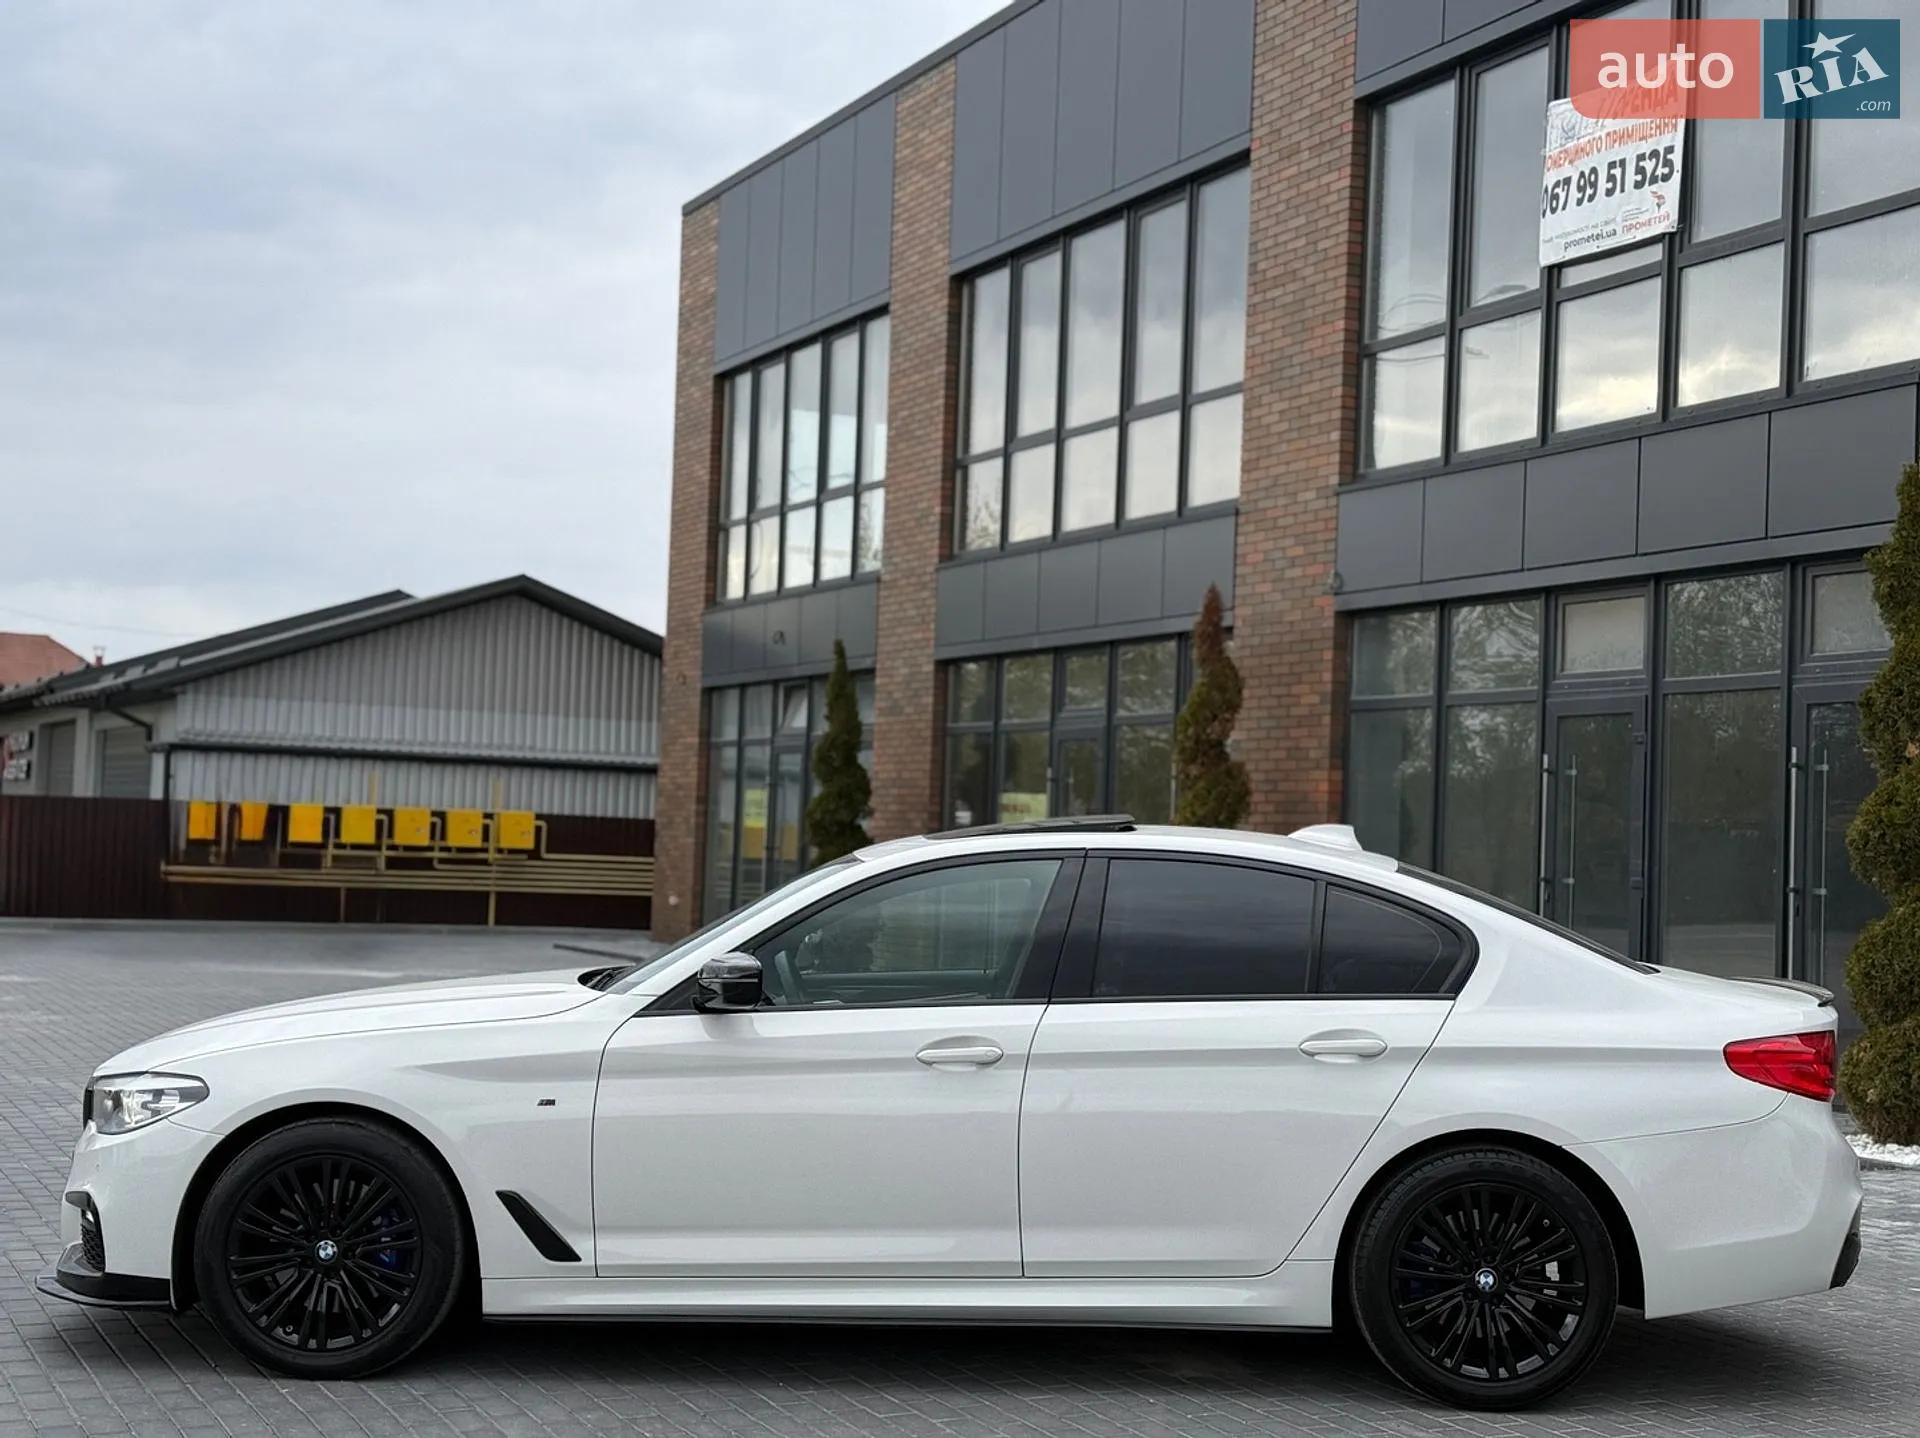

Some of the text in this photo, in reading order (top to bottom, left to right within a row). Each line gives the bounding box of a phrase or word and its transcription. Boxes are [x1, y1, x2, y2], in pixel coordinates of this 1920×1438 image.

[1576, 166, 1599, 207] 99
[1604, 157, 1626, 198] 51
[1633, 144, 1675, 190] 525
[1563, 228, 1617, 252] prometei.ua
